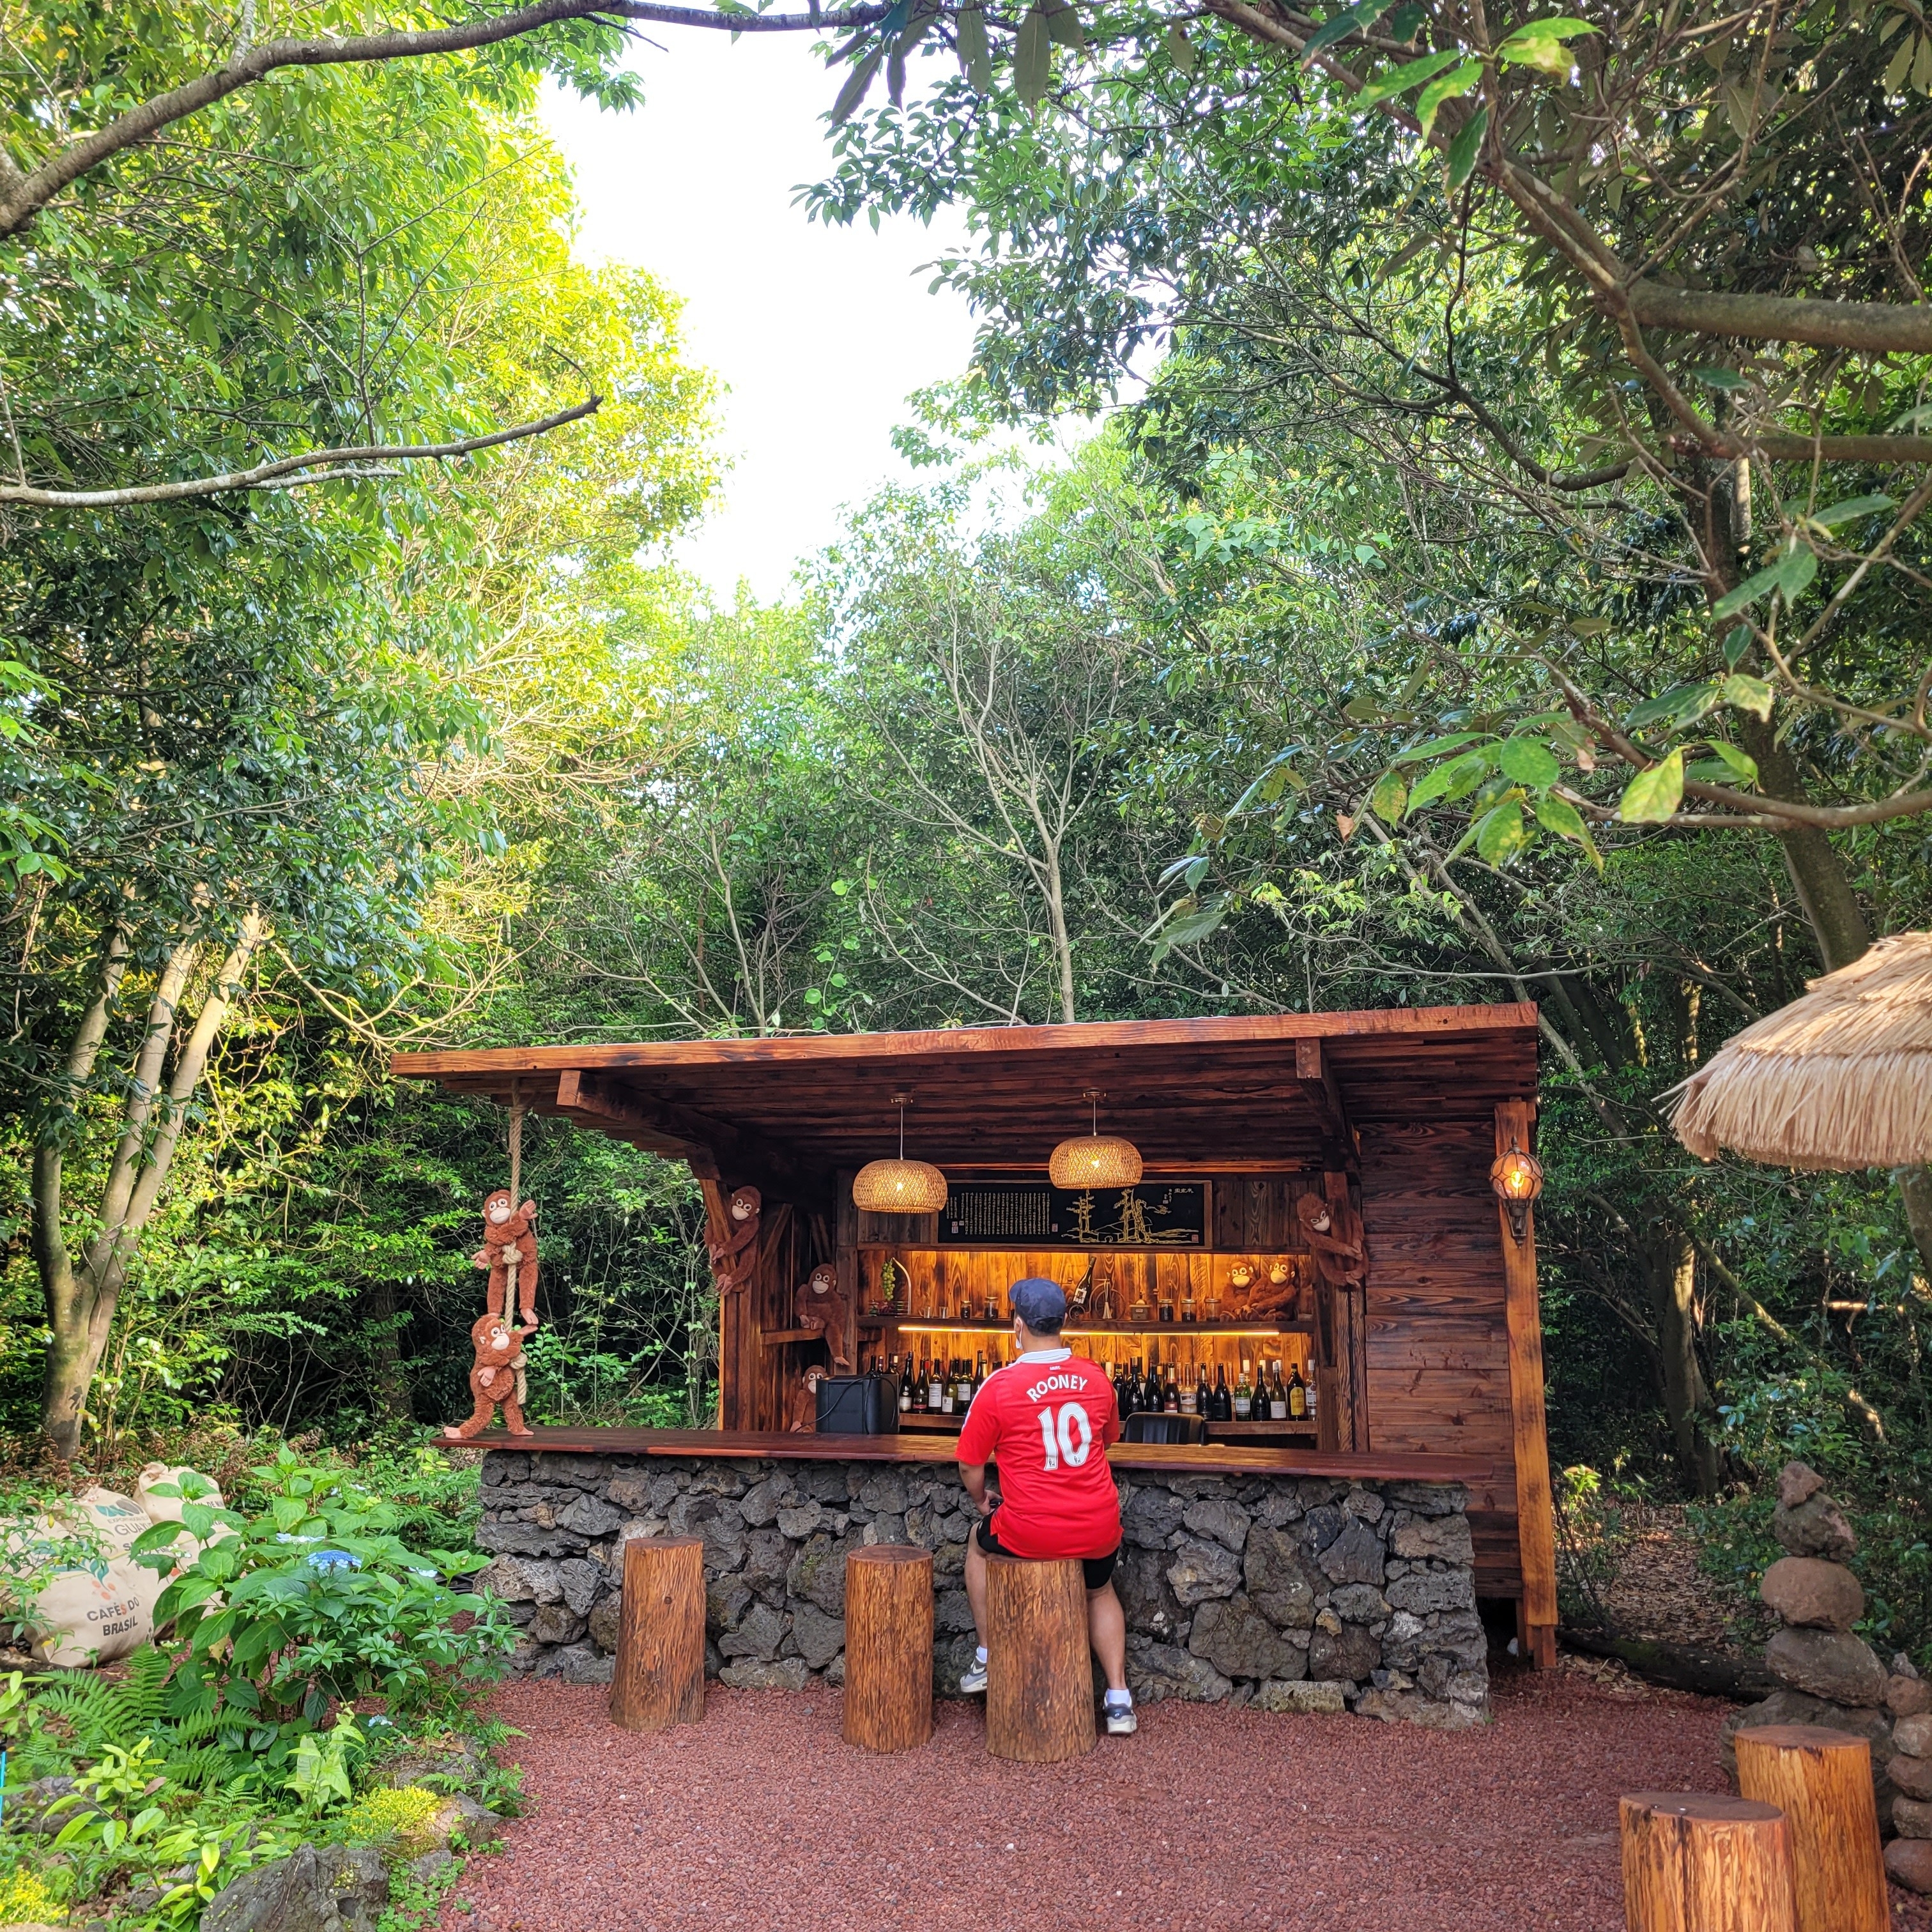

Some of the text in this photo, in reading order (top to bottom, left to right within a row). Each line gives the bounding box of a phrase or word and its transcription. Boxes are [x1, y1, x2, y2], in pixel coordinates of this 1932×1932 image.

[1026, 1374, 1088, 1402] ROONEY
[1038, 1402, 1092, 1470] 10
[87, 1597, 139, 1621] CAFÉS DO
[103, 1615, 138, 1636] BRASIL
